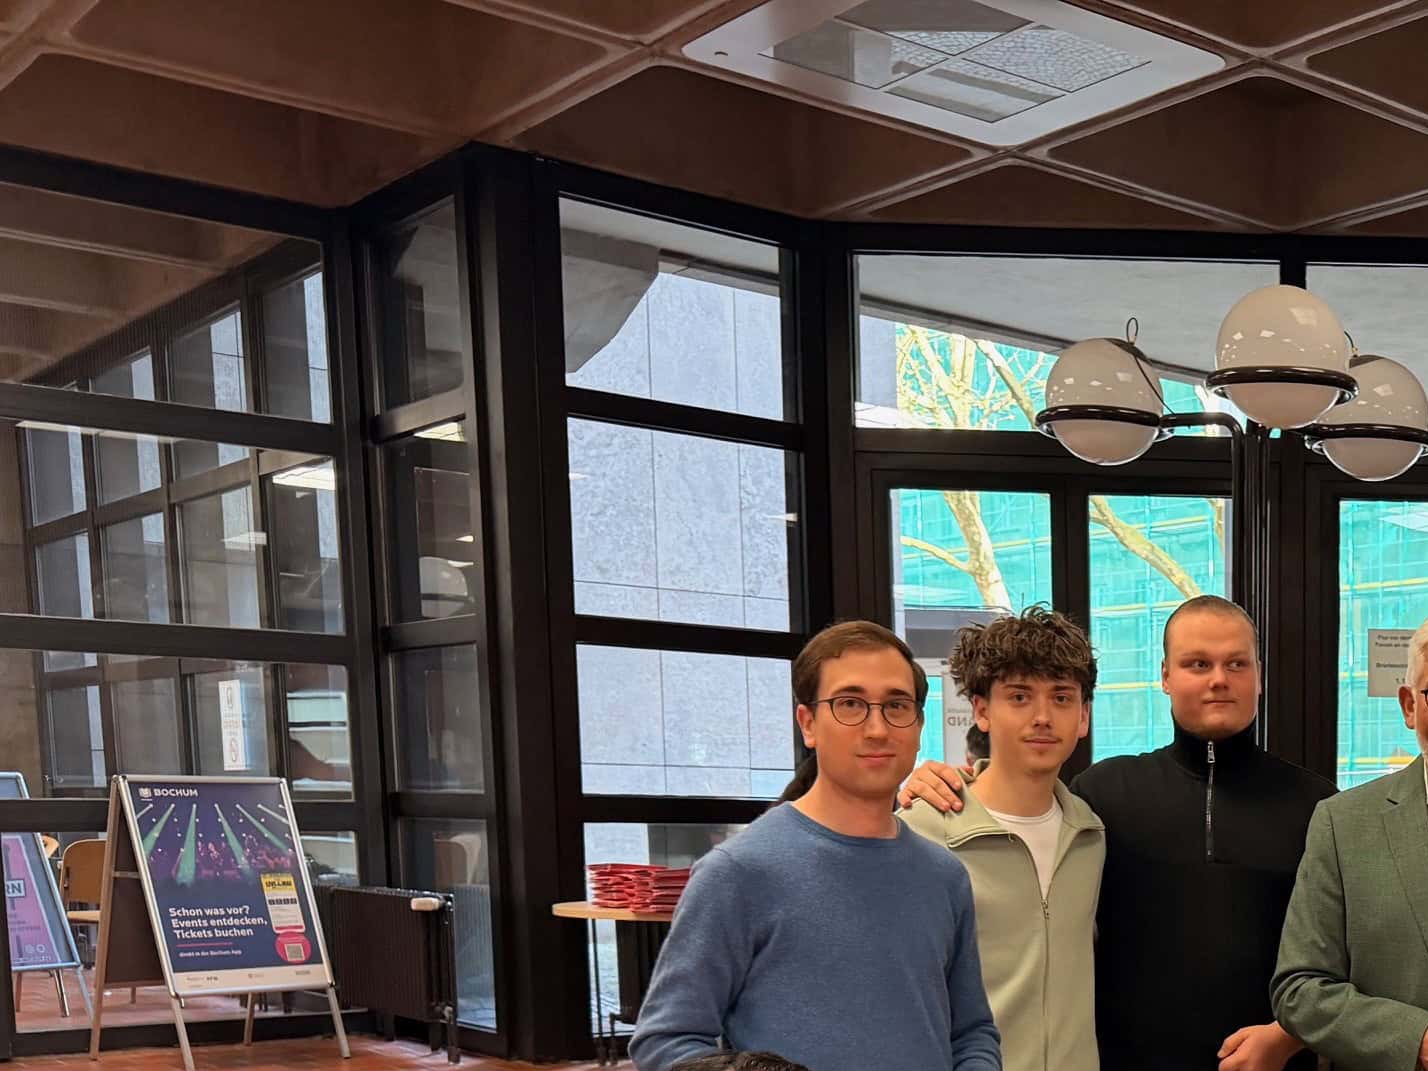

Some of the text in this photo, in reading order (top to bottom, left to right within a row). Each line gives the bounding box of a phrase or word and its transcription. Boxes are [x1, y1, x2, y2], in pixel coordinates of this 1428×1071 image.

[153, 788, 199, 798] BOCHUM
[168, 905, 250, 917] Schon was vor?
[171, 916, 268, 928] Events entdecken,
[173, 927, 254, 939] Tickets buchen
